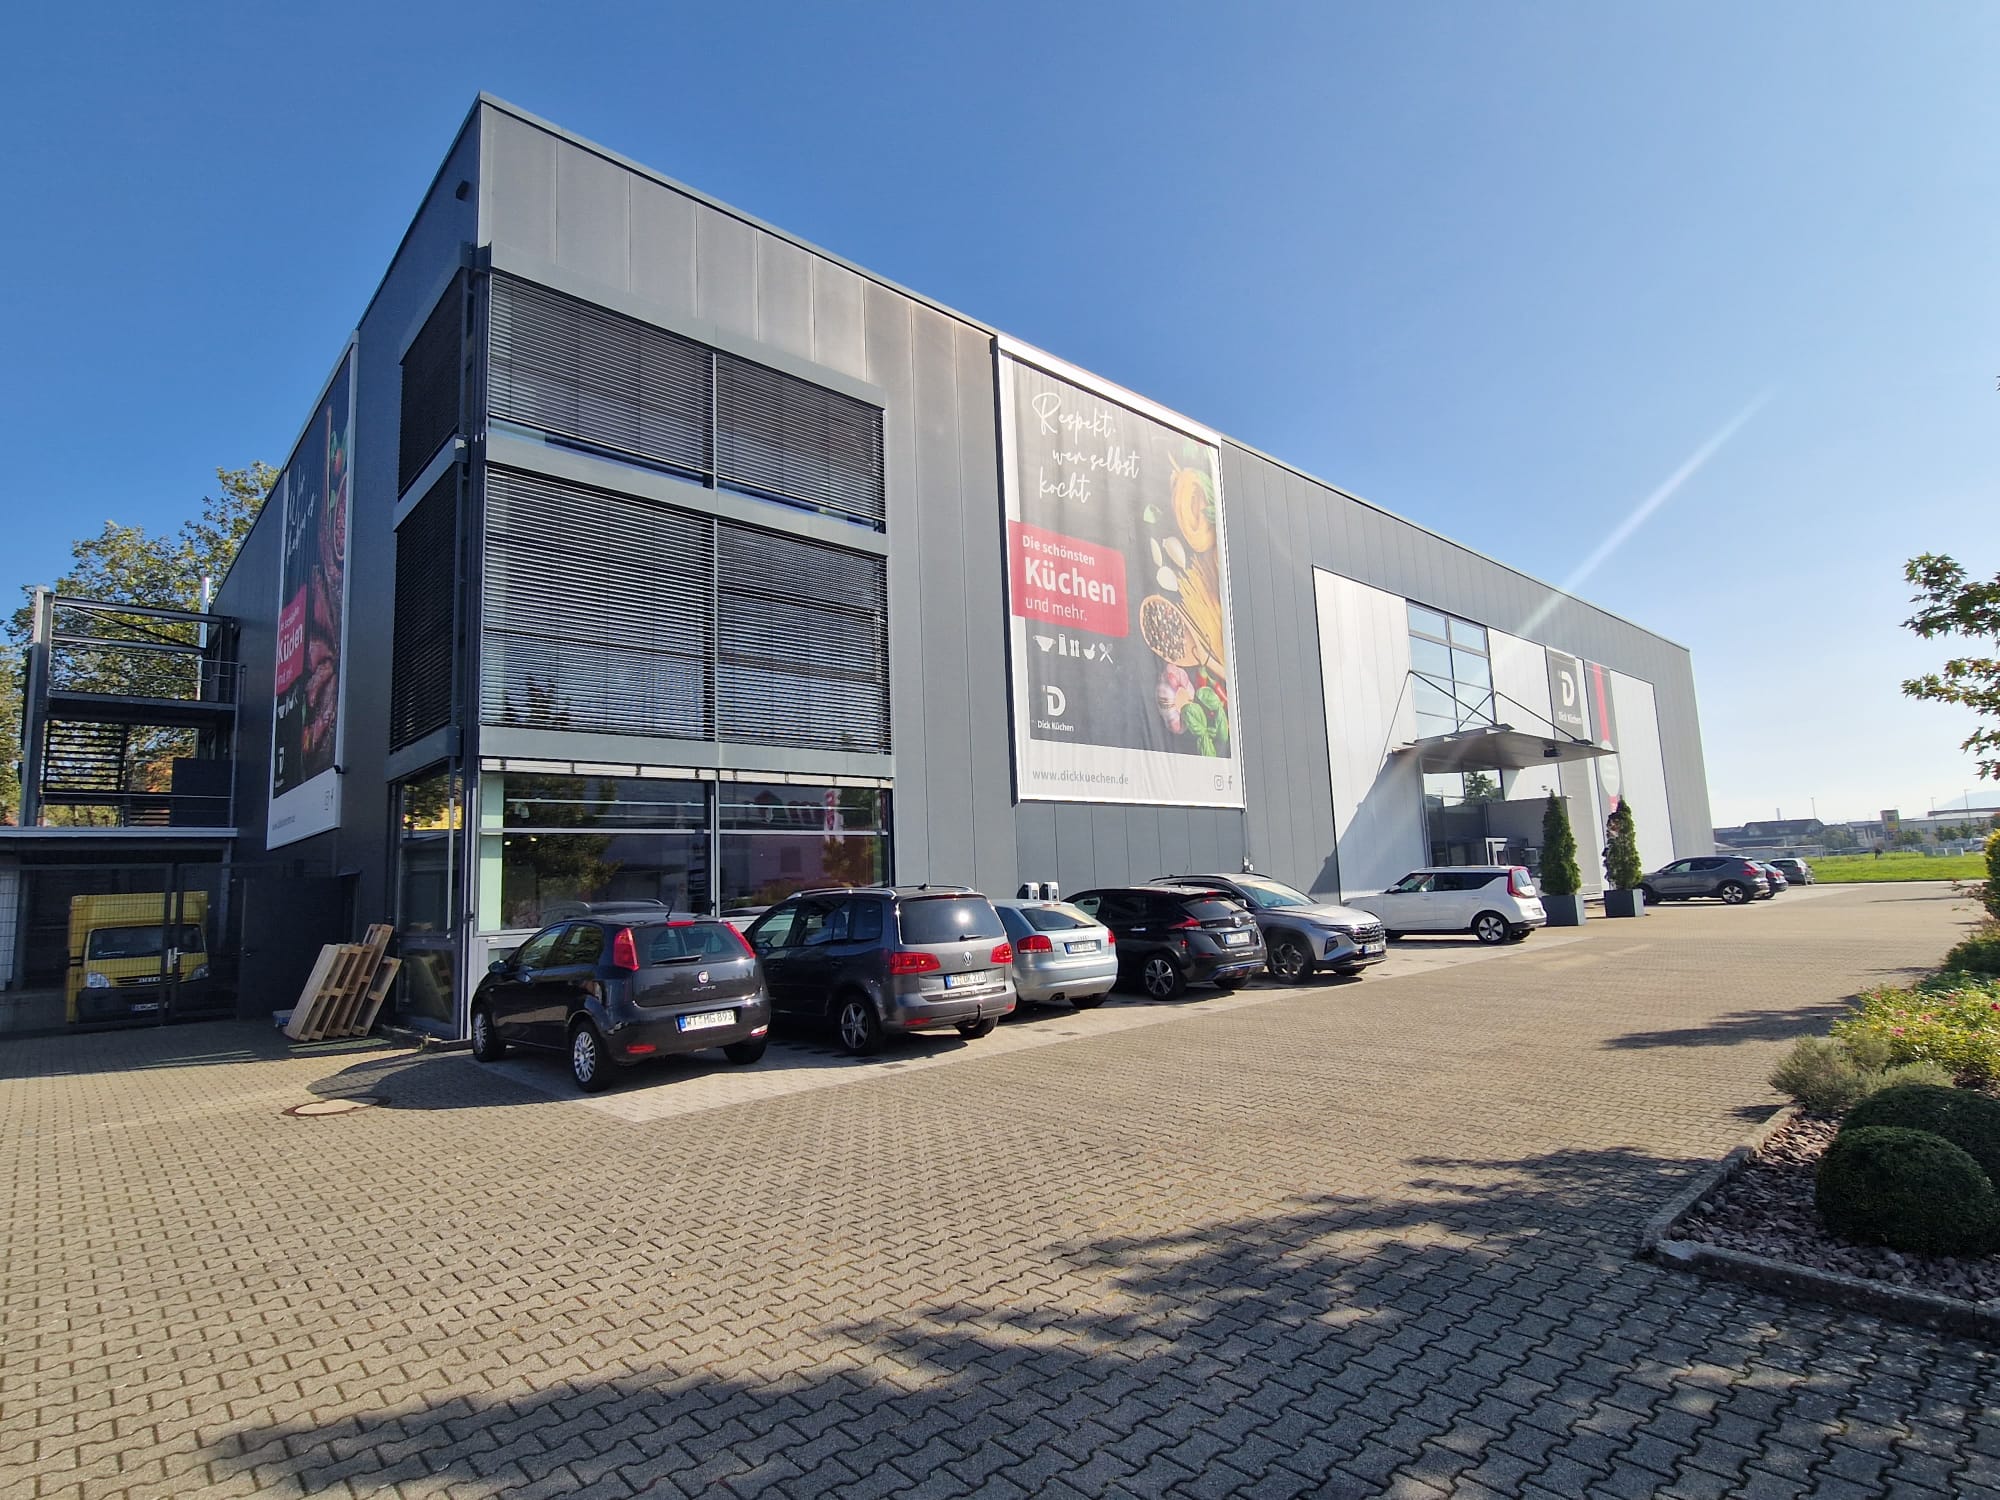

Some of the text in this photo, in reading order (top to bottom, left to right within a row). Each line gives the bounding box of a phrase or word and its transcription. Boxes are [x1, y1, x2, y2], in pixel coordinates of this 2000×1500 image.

[1089, 445, 1141, 479] selbst
[1022, 534, 1096, 567] Die schönsten
[1025, 556, 1117, 606] Küchen
[1025, 596, 1088, 622] und mehr.
[1037, 720, 1075, 732] Dick Küchen
[1032, 769, 1129, 785] www.dickkuechen.de
